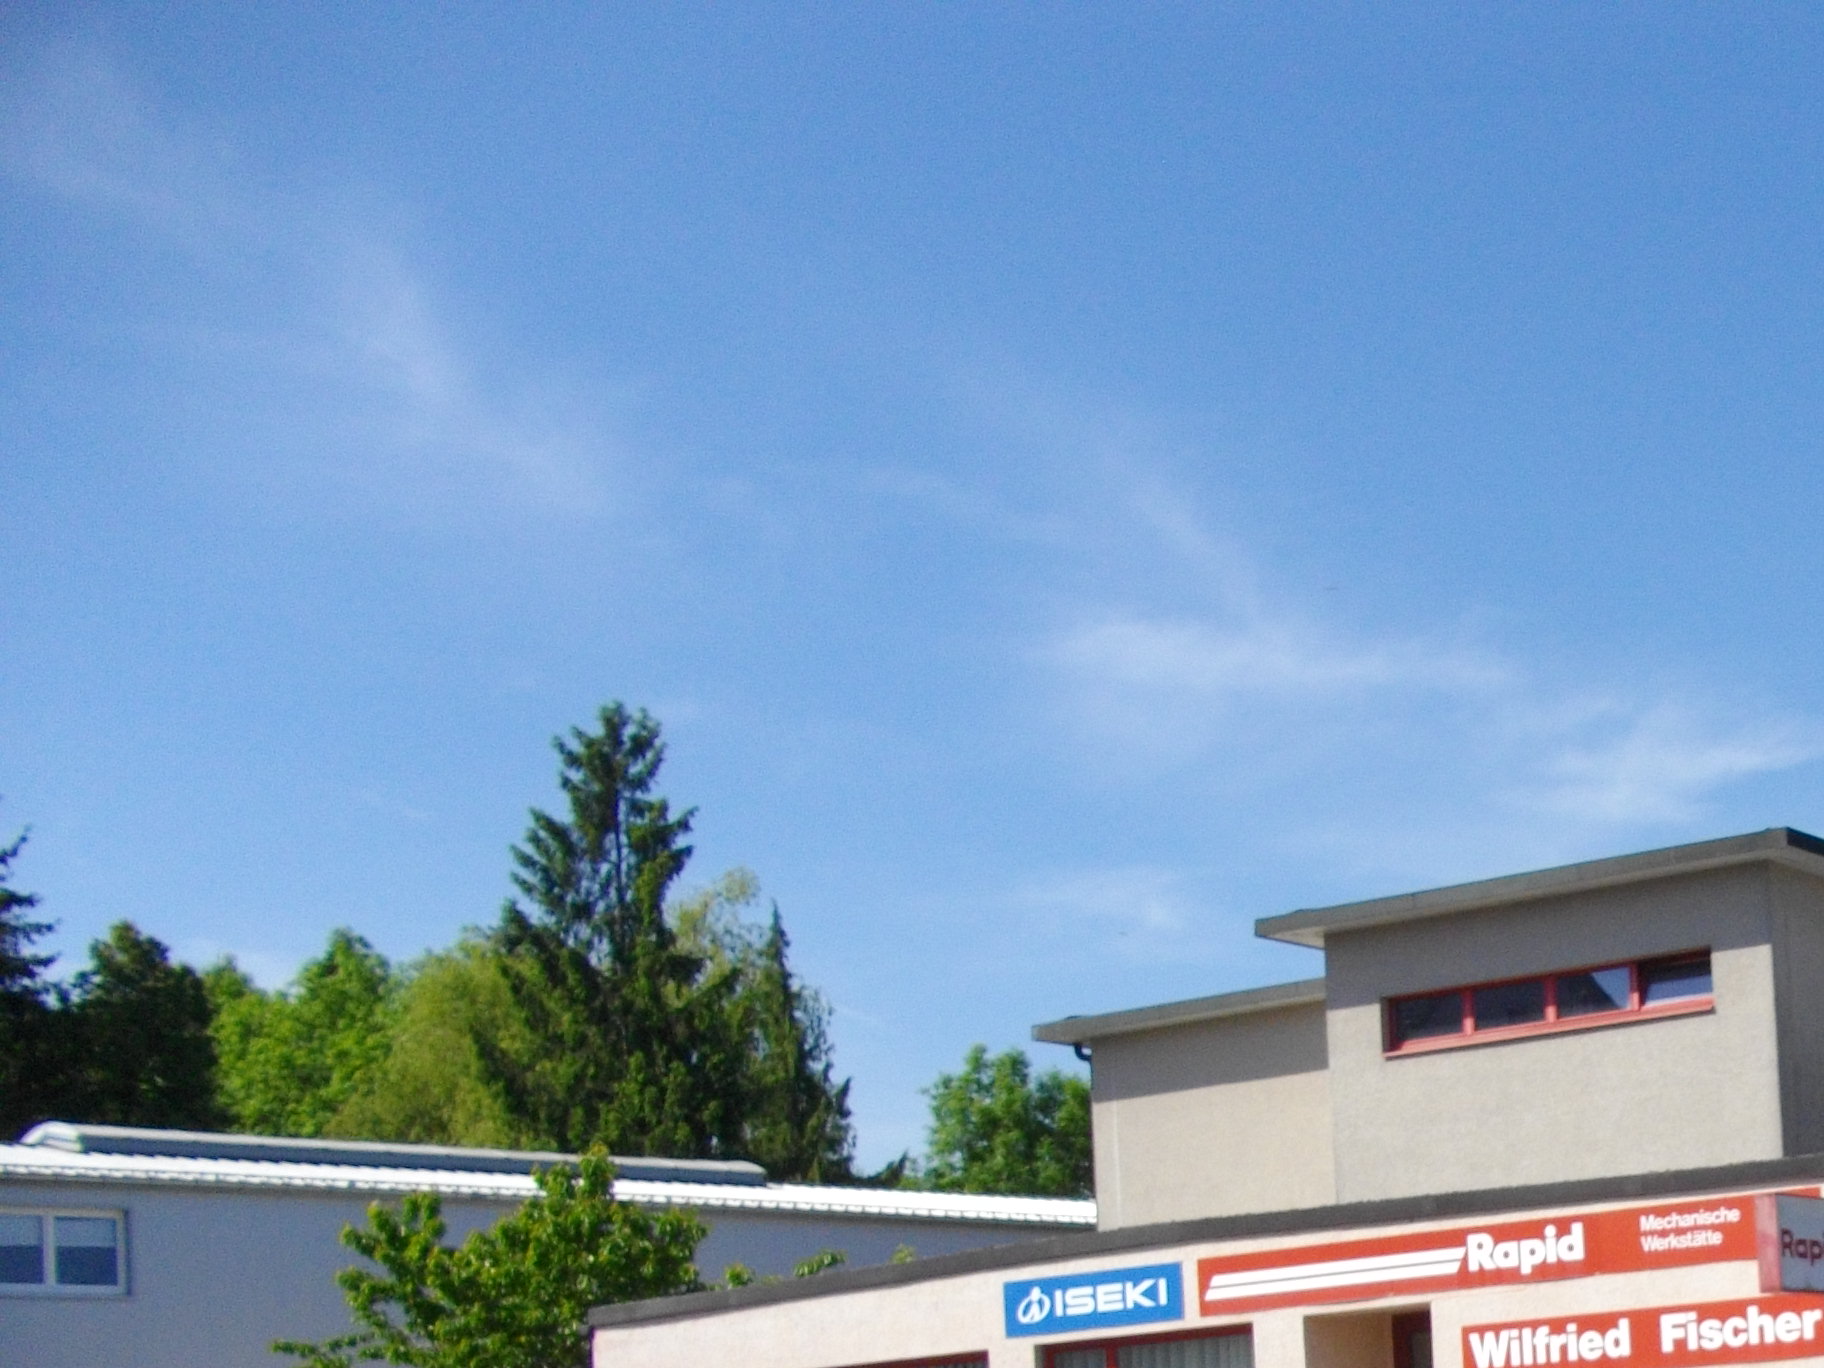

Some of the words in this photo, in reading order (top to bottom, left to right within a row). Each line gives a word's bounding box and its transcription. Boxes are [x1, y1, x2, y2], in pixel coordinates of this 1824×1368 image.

[1639, 1206, 1741, 1232] Mechanische
[1466, 1221, 1585, 1275] Rapid
[1640, 1229, 1723, 1252] Werkstätte
[1054, 1277, 1168, 1318] ISEKI
[1660, 1304, 1823, 1354] Fischer
